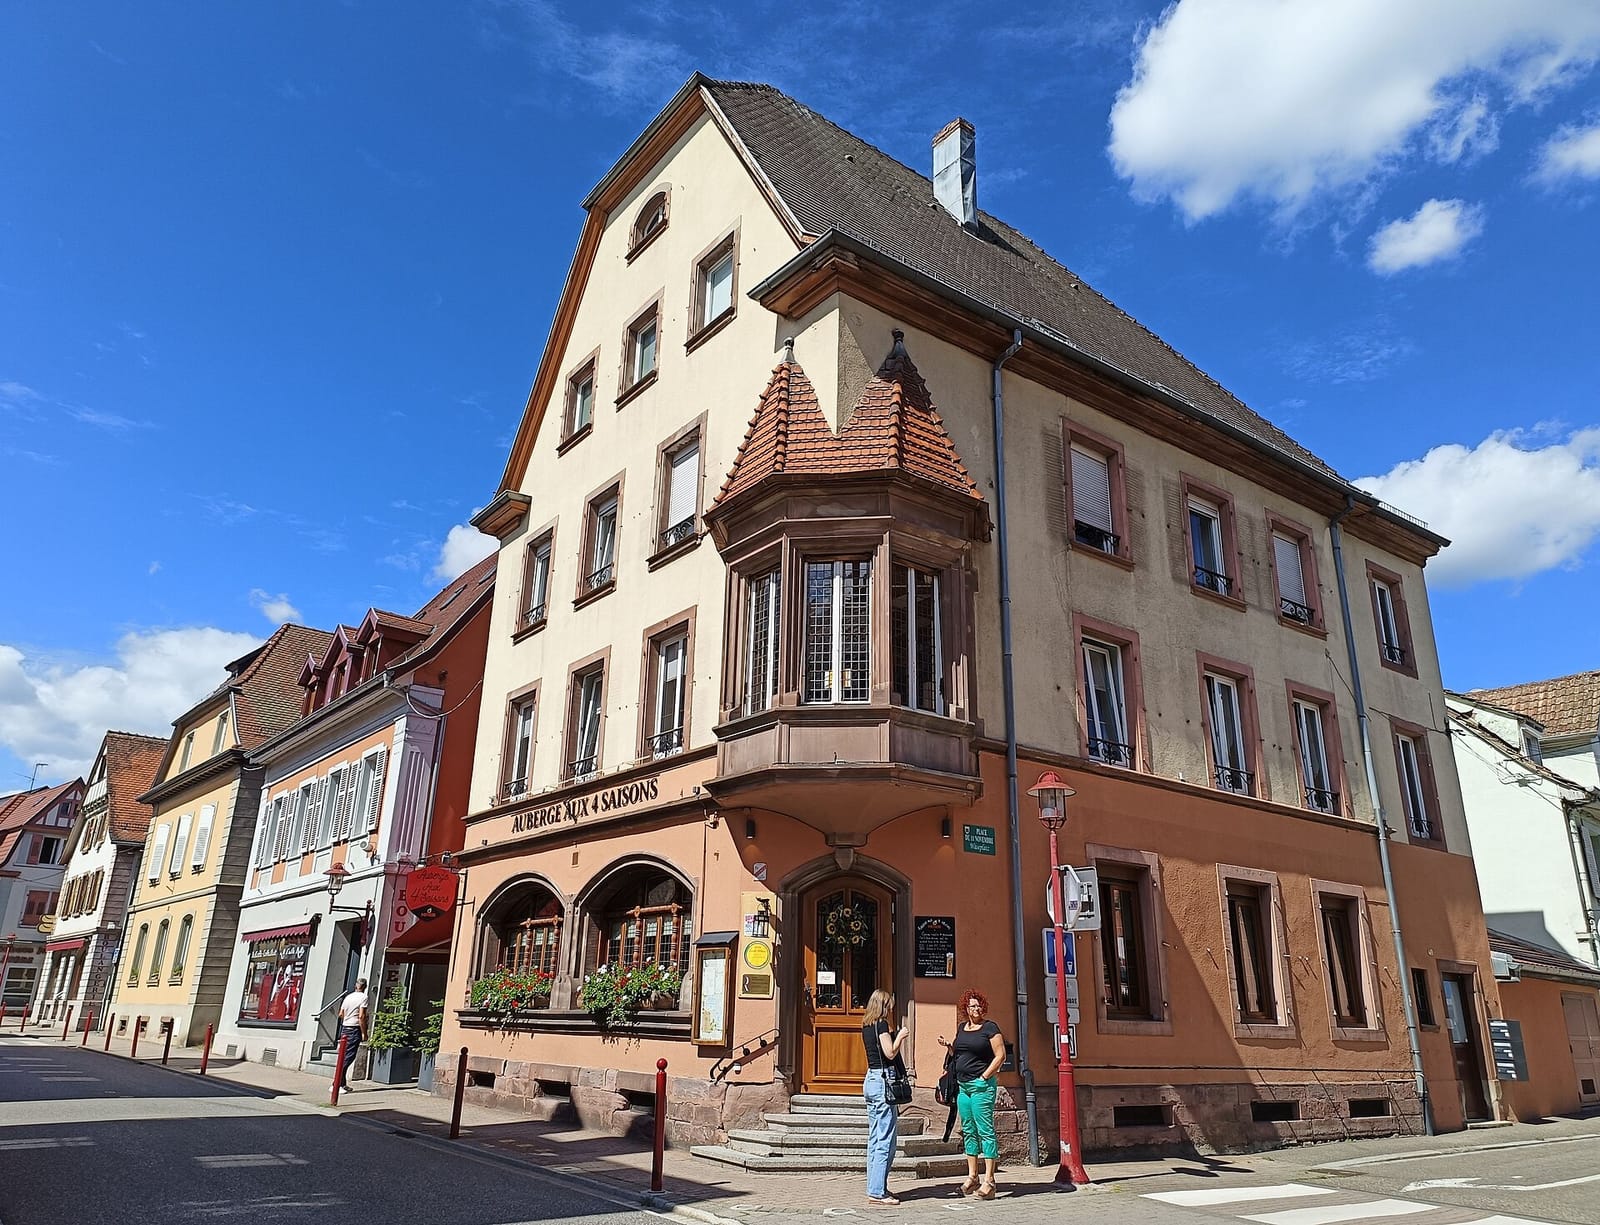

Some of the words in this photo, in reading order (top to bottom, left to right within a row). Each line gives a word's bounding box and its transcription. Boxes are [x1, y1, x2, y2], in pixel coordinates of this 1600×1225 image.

[511, 803, 562, 834] AUBERGE
[563, 797, 589, 822] AUX
[591, 793, 599, 815] 4
[600, 778, 658, 812] SAISONS
[975, 827, 988, 836] PLACE
[416, 870, 449, 882] Auberge
[422, 881, 441, 893] Aux
[410, 887, 420, 902] 4
[420, 891, 449, 903] Saisons
